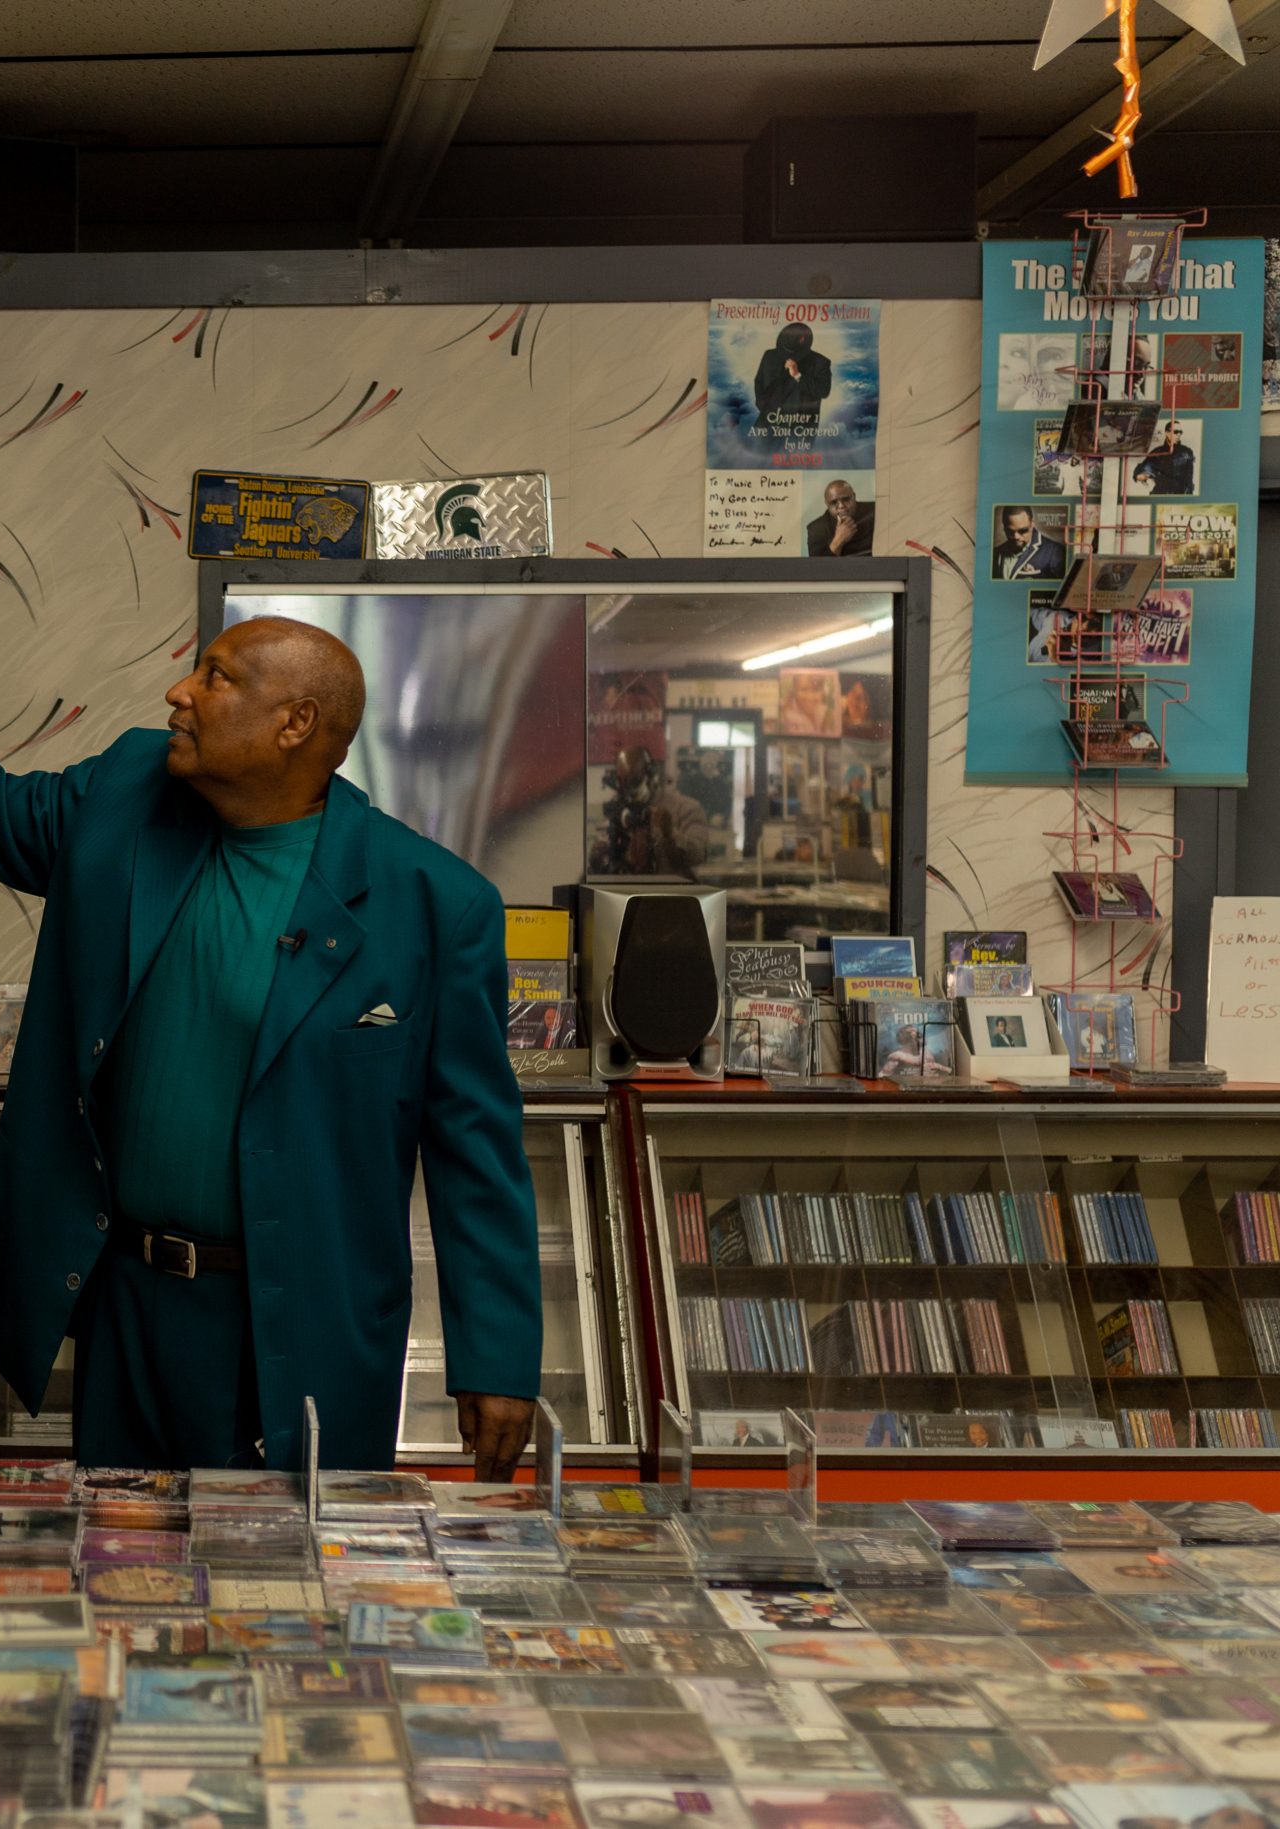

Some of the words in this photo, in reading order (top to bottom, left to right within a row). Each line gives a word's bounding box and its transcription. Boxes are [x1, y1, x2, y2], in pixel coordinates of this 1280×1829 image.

[1011, 260, 1065, 290] The
[716, 301, 781, 325] Presenting
[785, 304, 831, 322] GOD'S
[1145, 297, 1199, 321] You
[766, 407, 812, 424] Chapter
[746, 426, 768, 437] Are
[771, 426, 792, 438] You
[793, 425, 840, 438] Covered
[784, 436, 796, 452] by
[797, 436, 812, 451] the
[204, 503, 233, 514] HOME
[200, 512, 215, 523] OF
[216, 513, 235, 525] THE
[241, 516, 302, 547] Jaguars
[425, 548, 472, 560] MICHIGAN
[471, 545, 502, 558] STATE
[971, 950, 1000, 962] Rev.
[514, 978, 542, 990] Rev.
[851, 980, 914, 991] BOUNCING
[523, 989, 562, 1001] Smith
[748, 1002, 775, 1012] WHEN
